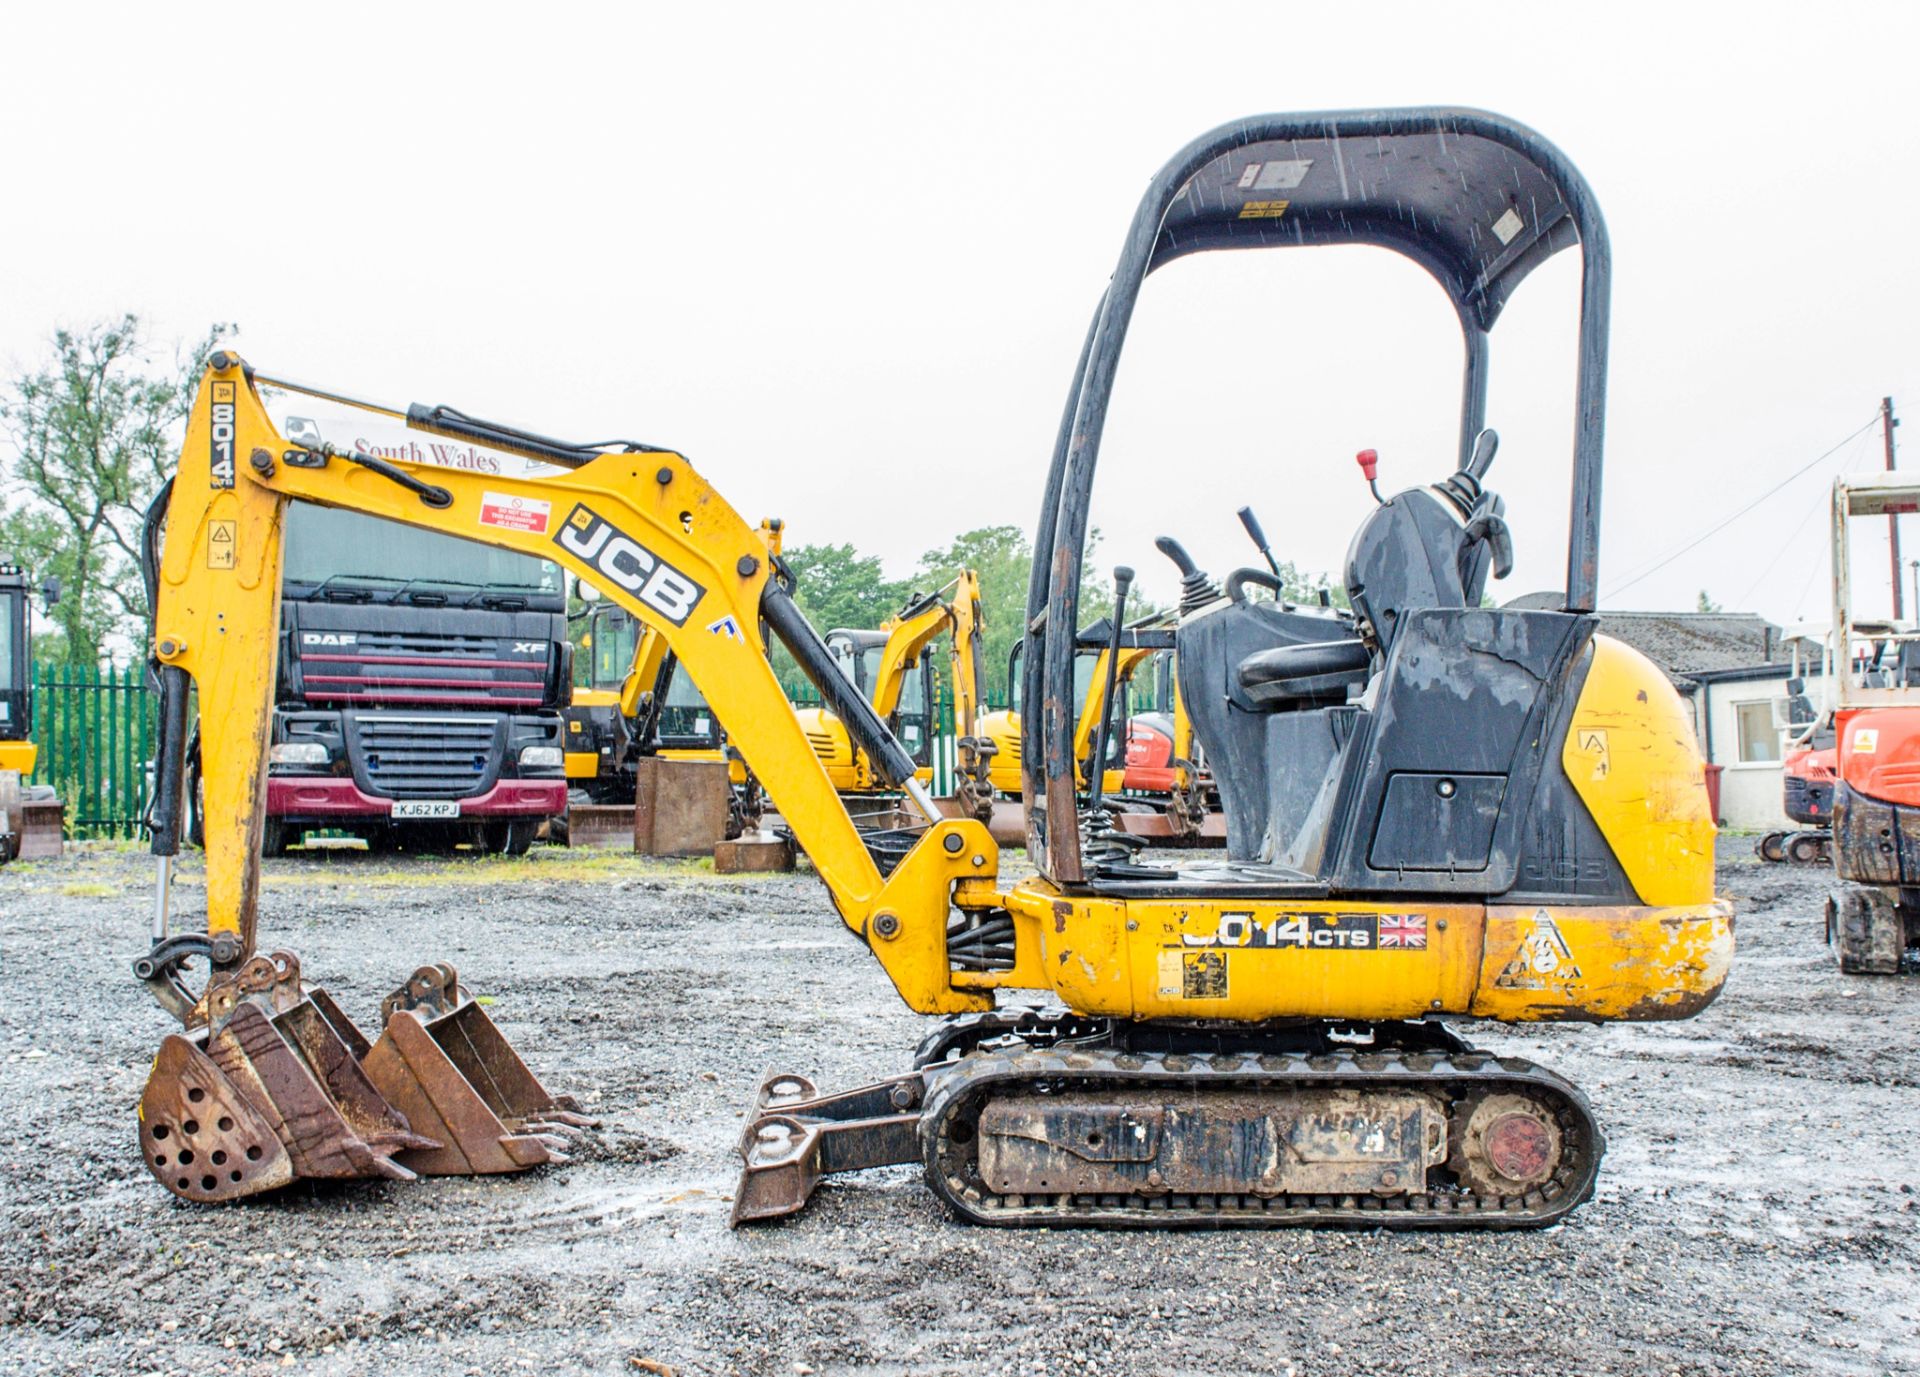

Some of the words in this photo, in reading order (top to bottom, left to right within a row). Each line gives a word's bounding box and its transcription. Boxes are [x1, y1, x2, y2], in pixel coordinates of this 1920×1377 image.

[212, 404, 234, 478] 8014
[355, 438, 422, 462] South
[430, 443, 499, 473] Wales
[560, 522, 698, 621] JCB
[303, 633, 357, 646] DAF
[512, 642, 547, 653] XF
[400, 805, 431, 815] KJ62
[434, 805, 457, 815] KPJ
[1526, 856, 1610, 881] JCB
